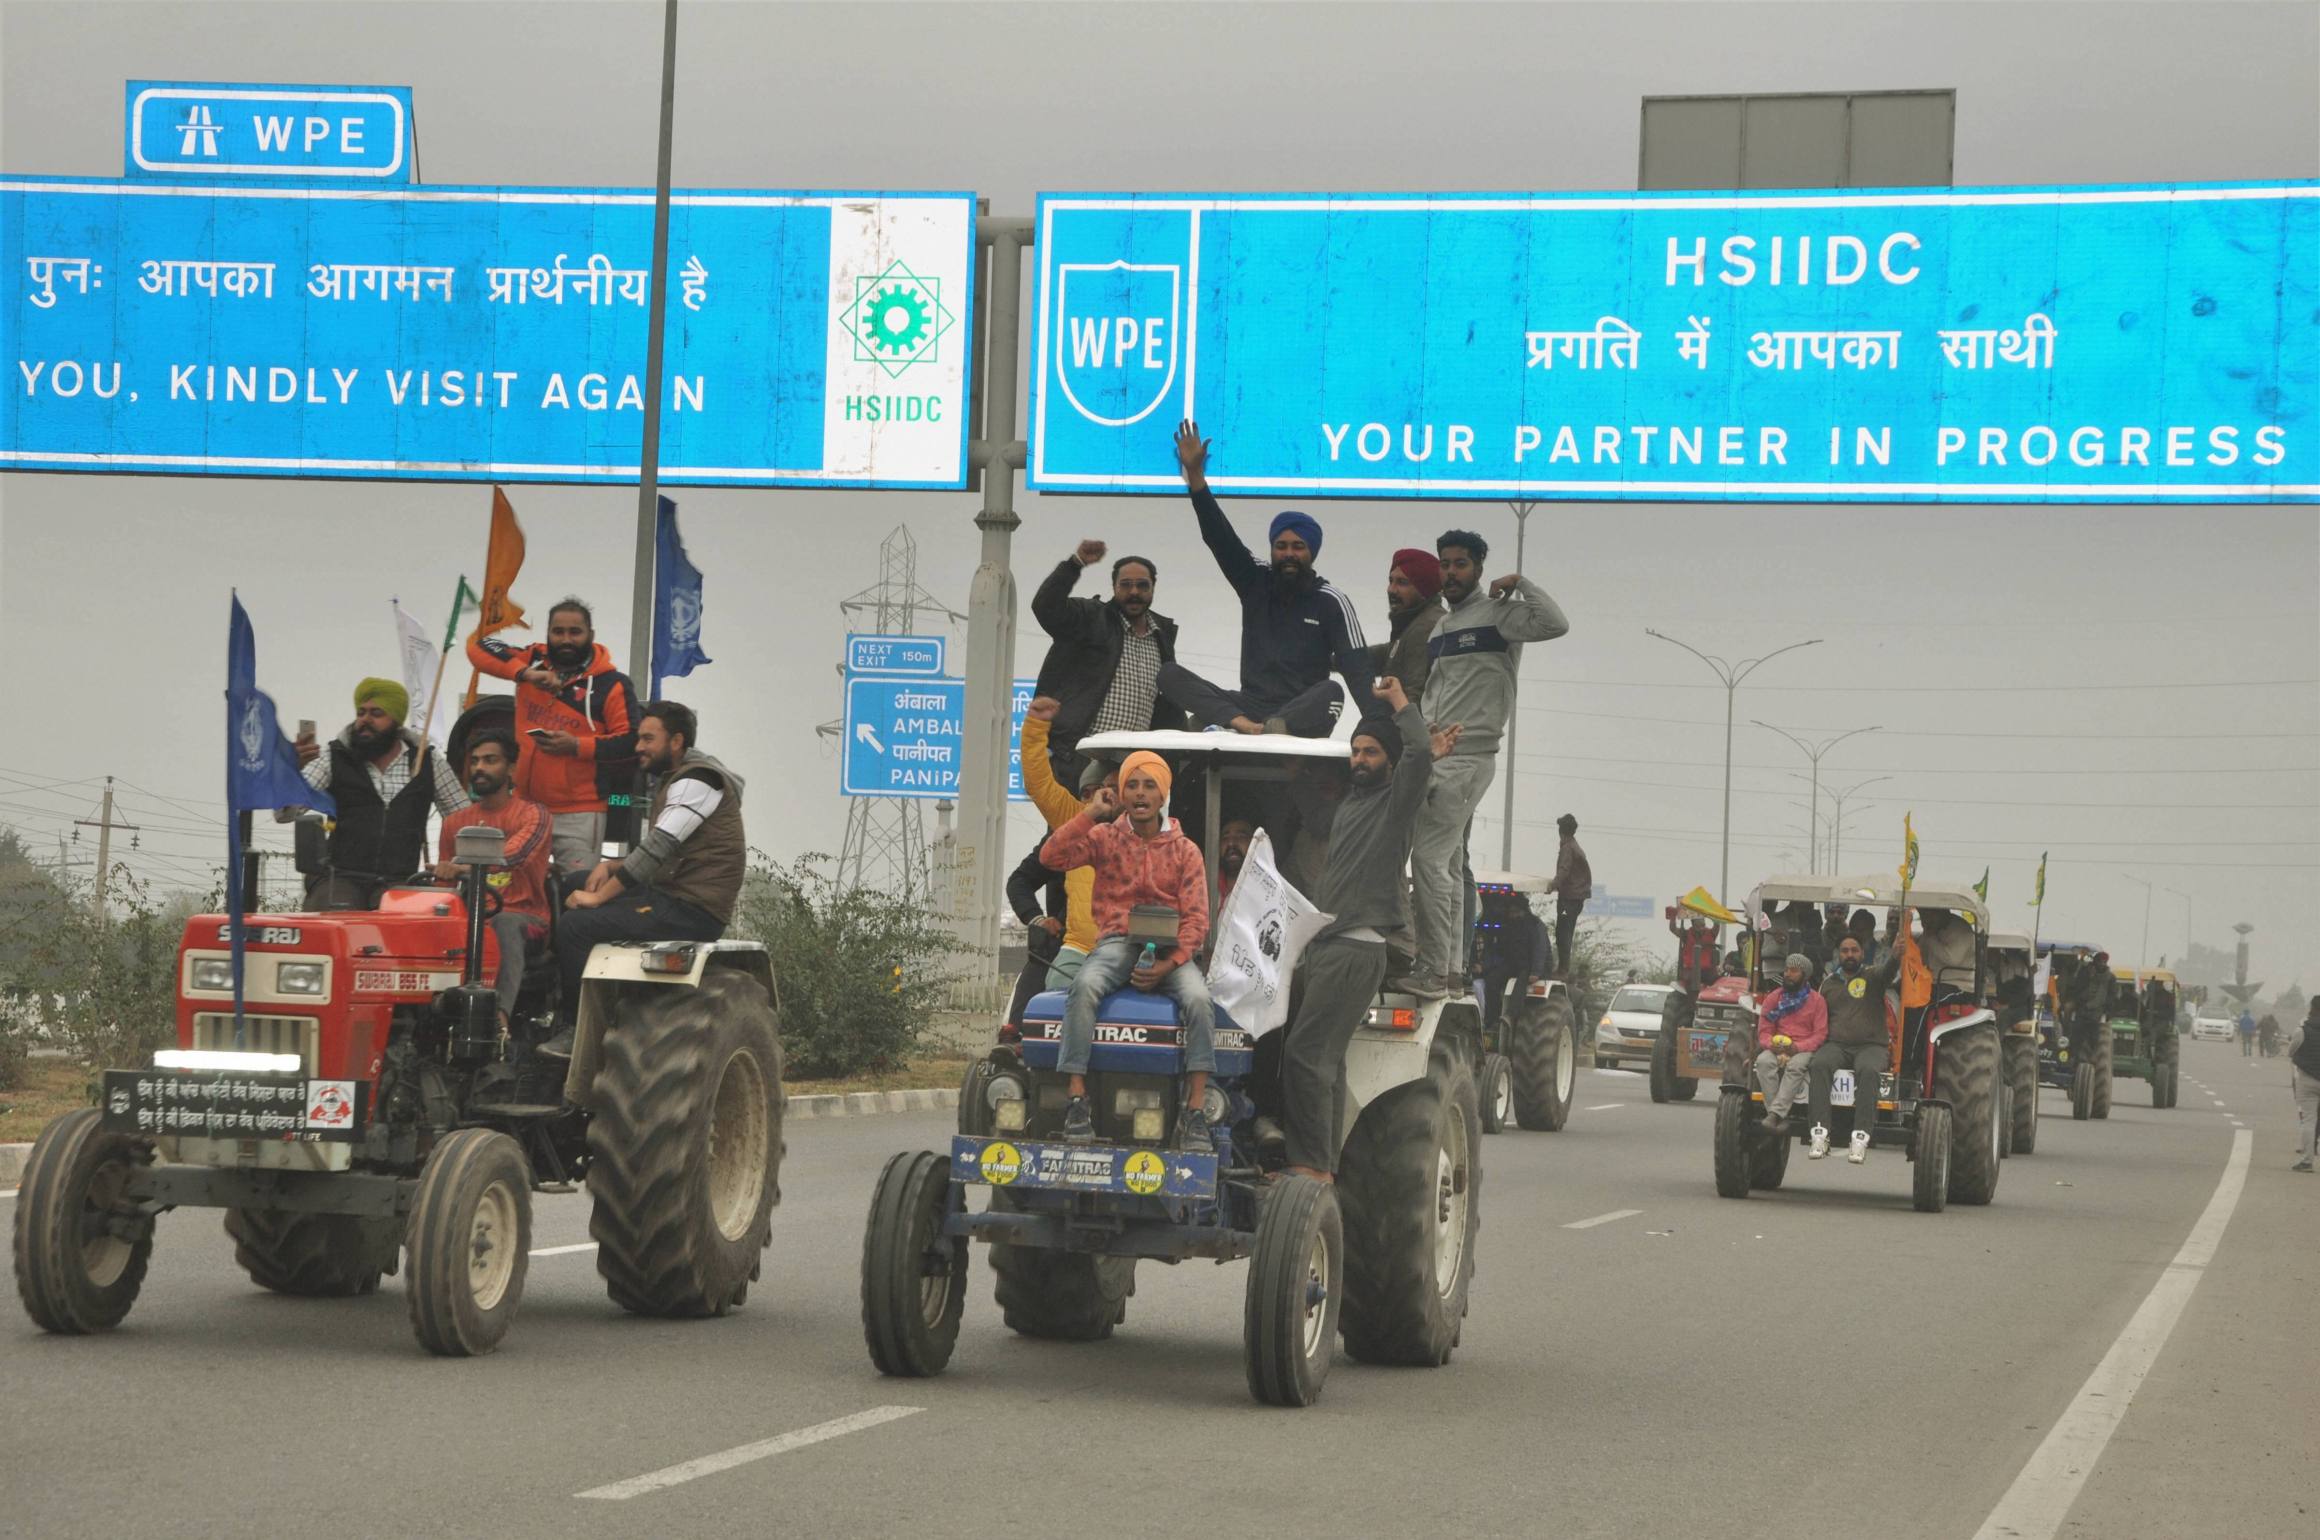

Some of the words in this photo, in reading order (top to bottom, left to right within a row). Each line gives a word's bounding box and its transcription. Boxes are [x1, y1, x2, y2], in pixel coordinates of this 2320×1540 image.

[254, 116, 365, 154] WPE
[1666, 232, 1922, 287] HSIIDC
[28, 257, 103, 309] पुनः
[139, 261, 277, 299] आपका
[307, 265, 455, 302] आगमन
[486, 254, 648, 306] प्रार्थनीय
[680, 256, 709, 311] है
[1071, 316, 1165, 370] WPE
[1526, 316, 1642, 371] प्रगति
[1676, 316, 1712, 371] में
[1748, 331, 1903, 371] आपका
[1938, 313, 2059, 370] साथी
[20, 361, 139, 402] YOU,
[171, 365, 359, 404] KINDLY
[386, 369, 518, 409] VISIT
[542, 373, 704, 412] AGAN
[846, 396, 942, 422] HSIIDC
[1323, 423, 1476, 464] YOUR
[1515, 426, 1789, 466] PARTNER
[1831, 427, 1892, 467] IN
[1937, 426, 2287, 469] PROGRESS
[858, 644, 892, 655] NEXT
[858, 656, 887, 667] EXIT
[902, 651, 932, 663] 150m
[894, 689, 947, 711] अंबाला
[894, 718, 963, 736] AMBAL
[892, 739, 952, 762] पानीपत
[1043, 1023, 1149, 1043] FATRAC
